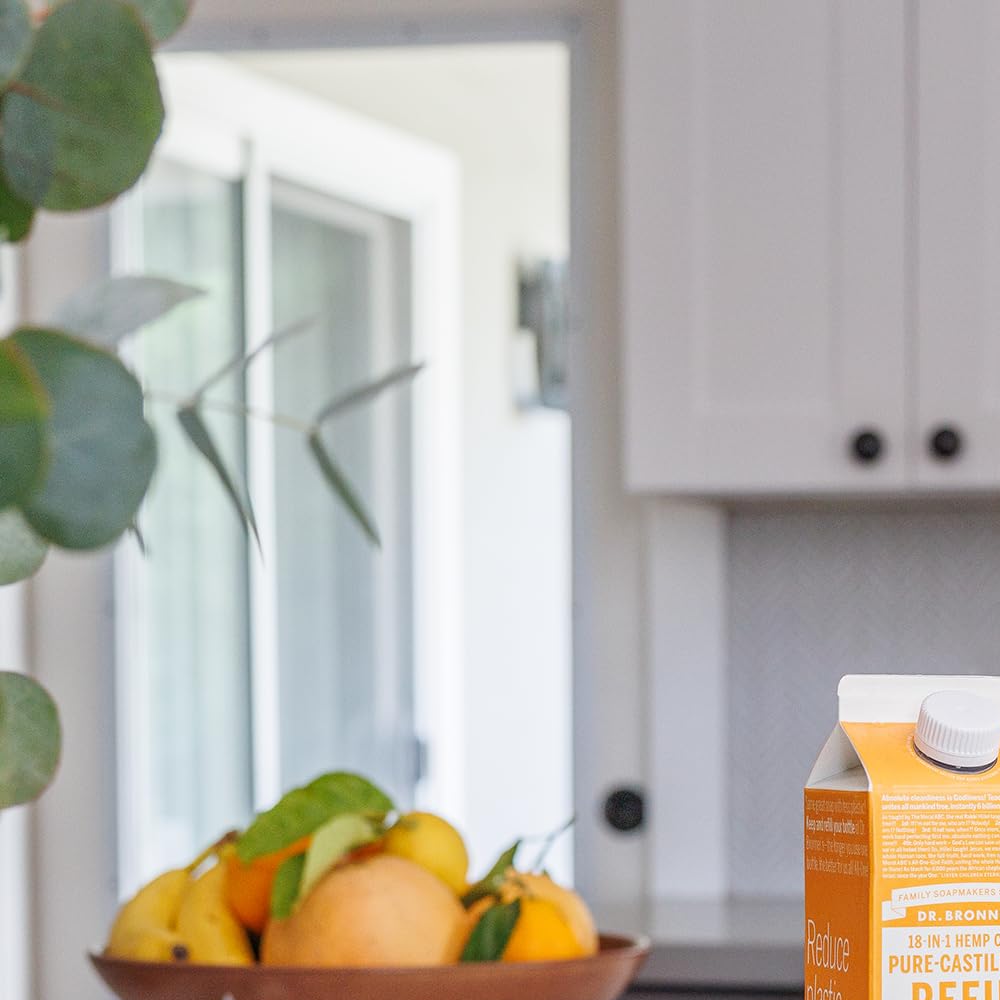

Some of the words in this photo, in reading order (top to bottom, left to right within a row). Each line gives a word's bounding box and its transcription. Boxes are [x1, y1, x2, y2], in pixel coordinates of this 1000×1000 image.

[899, 891, 931, 902] FAMILY
[934, 888, 996, 898] SOAPMAKERS
[917, 910, 943, 922] DR.
[807, 919, 850, 973] Reduce
[908, 934, 951, 949] 18-IN-1
[955, 933, 990, 948] HEMP
